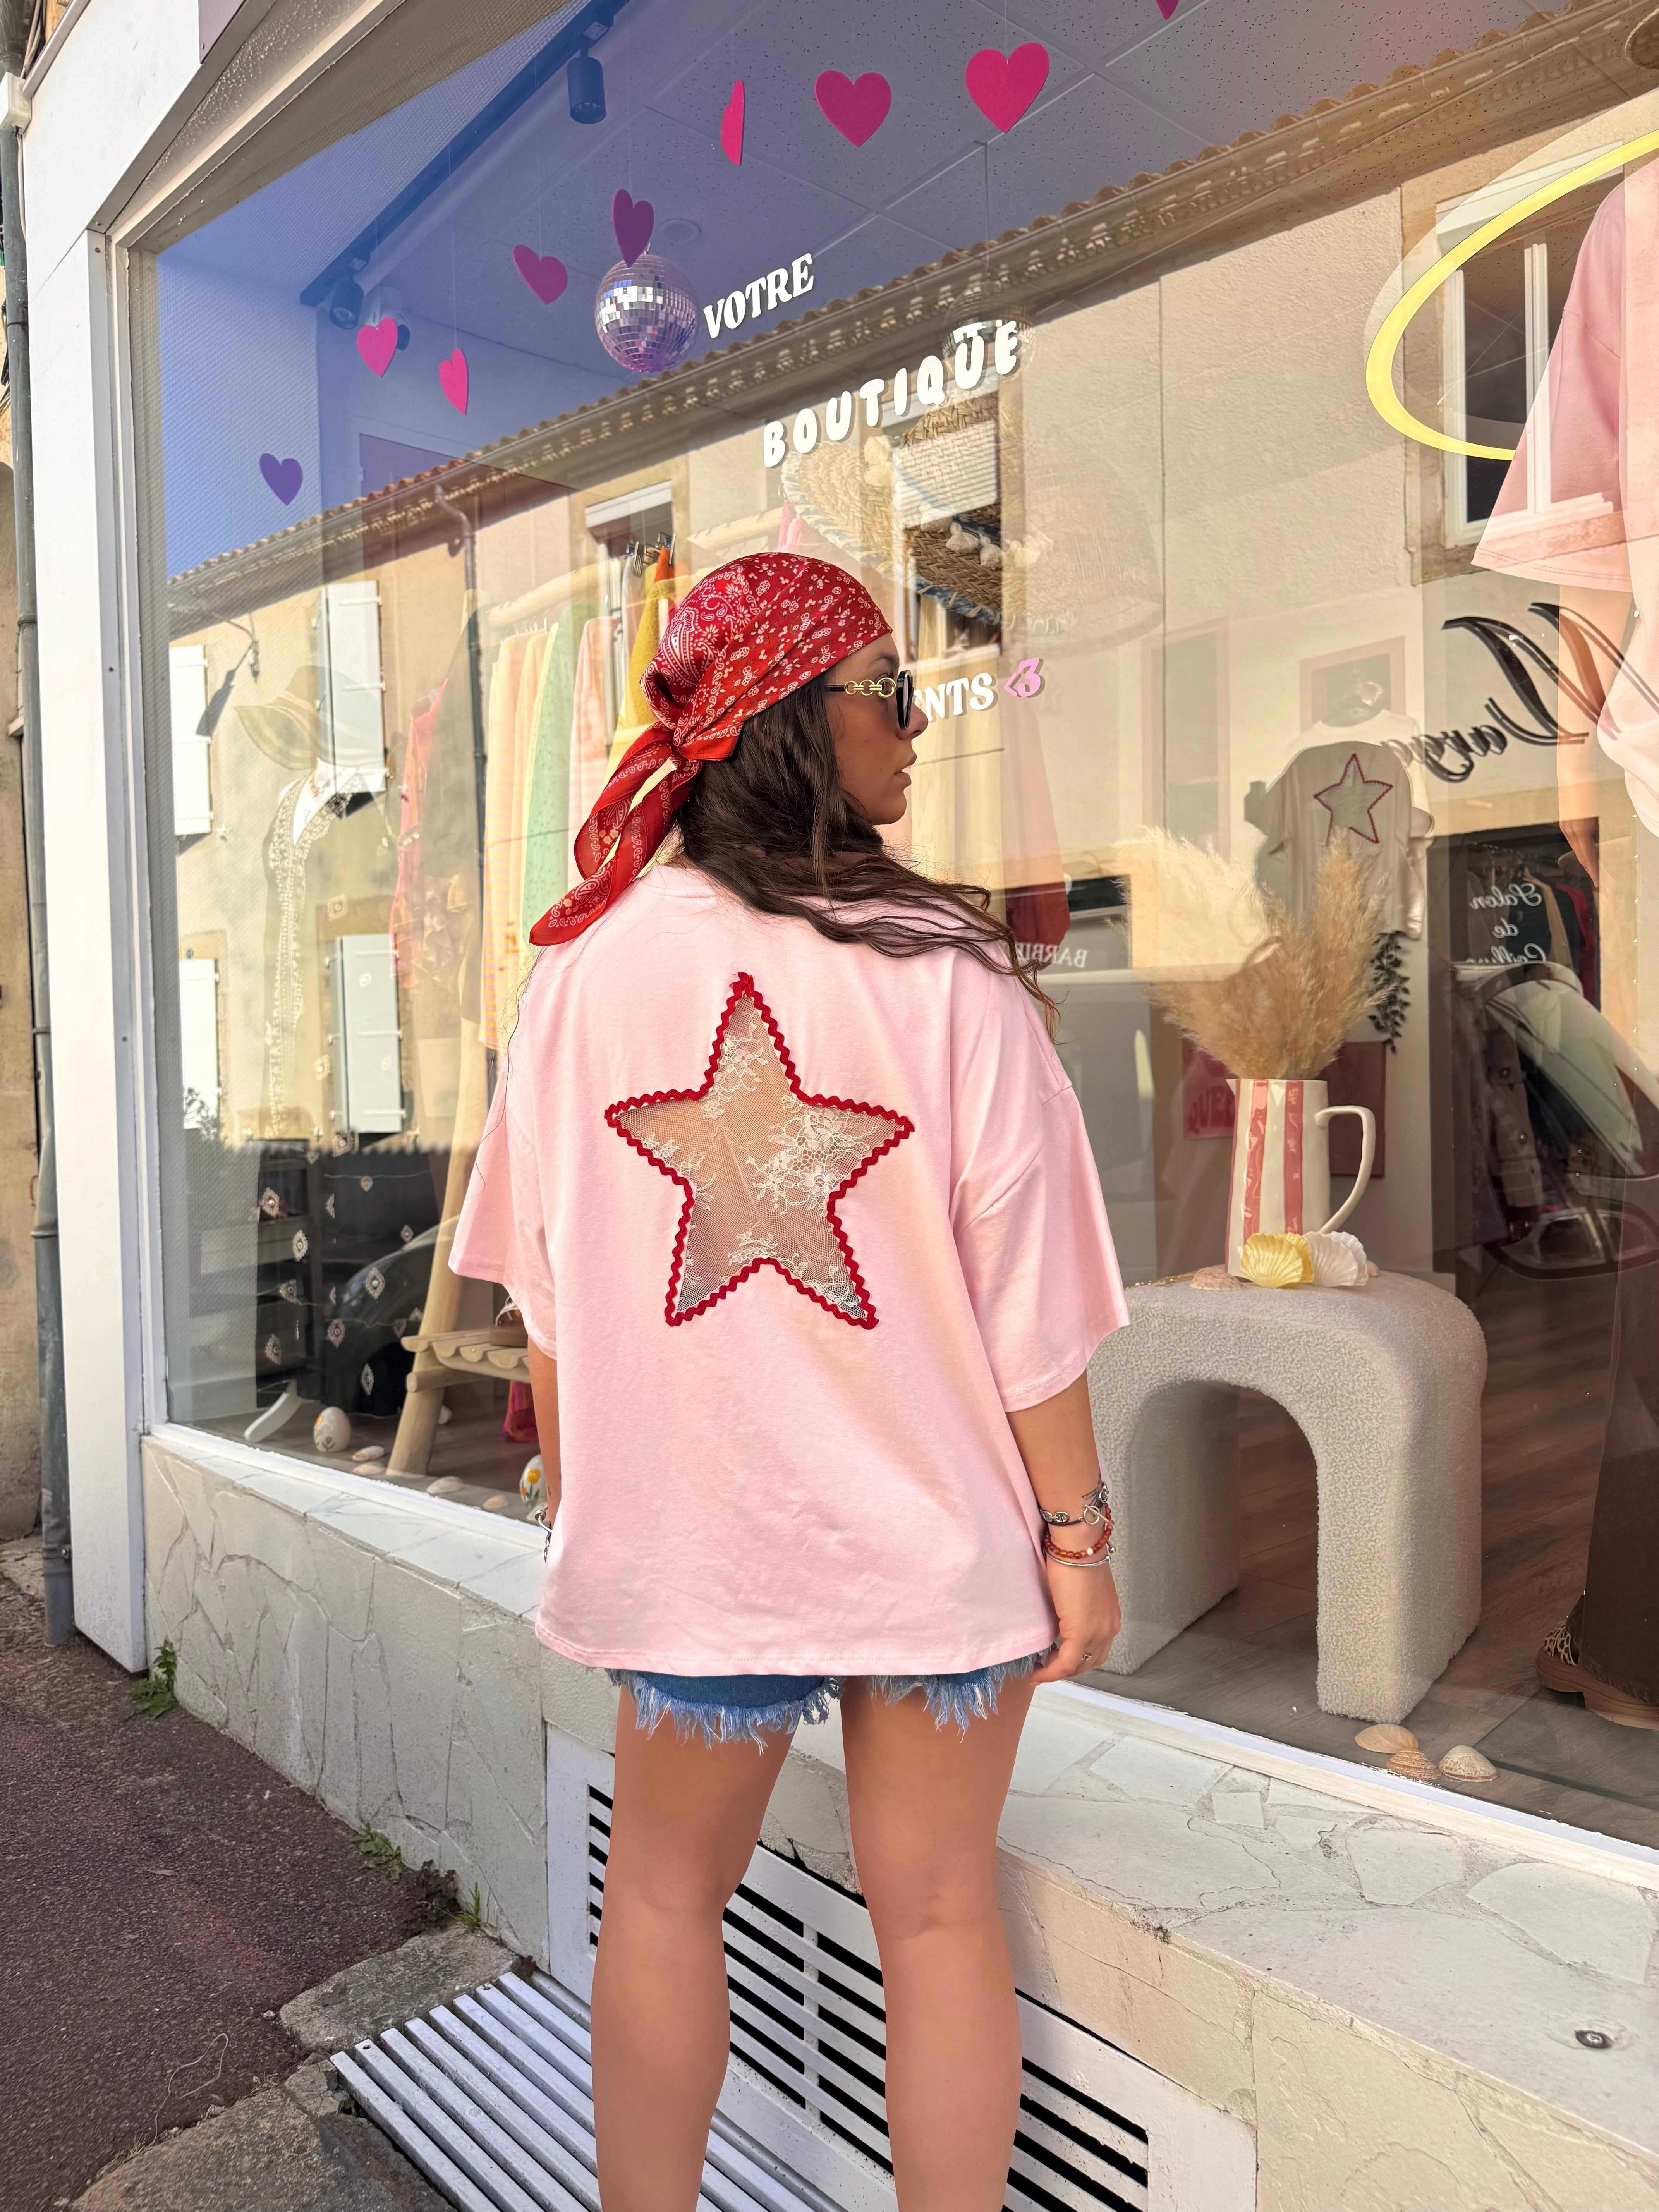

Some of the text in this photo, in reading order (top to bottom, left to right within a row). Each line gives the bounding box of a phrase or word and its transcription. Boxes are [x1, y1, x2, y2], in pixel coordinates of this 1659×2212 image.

[703, 252, 814, 339] VOTRE
[763, 320, 1018, 467] BOUTIQUE
[912, 672, 994, 723] NTS
